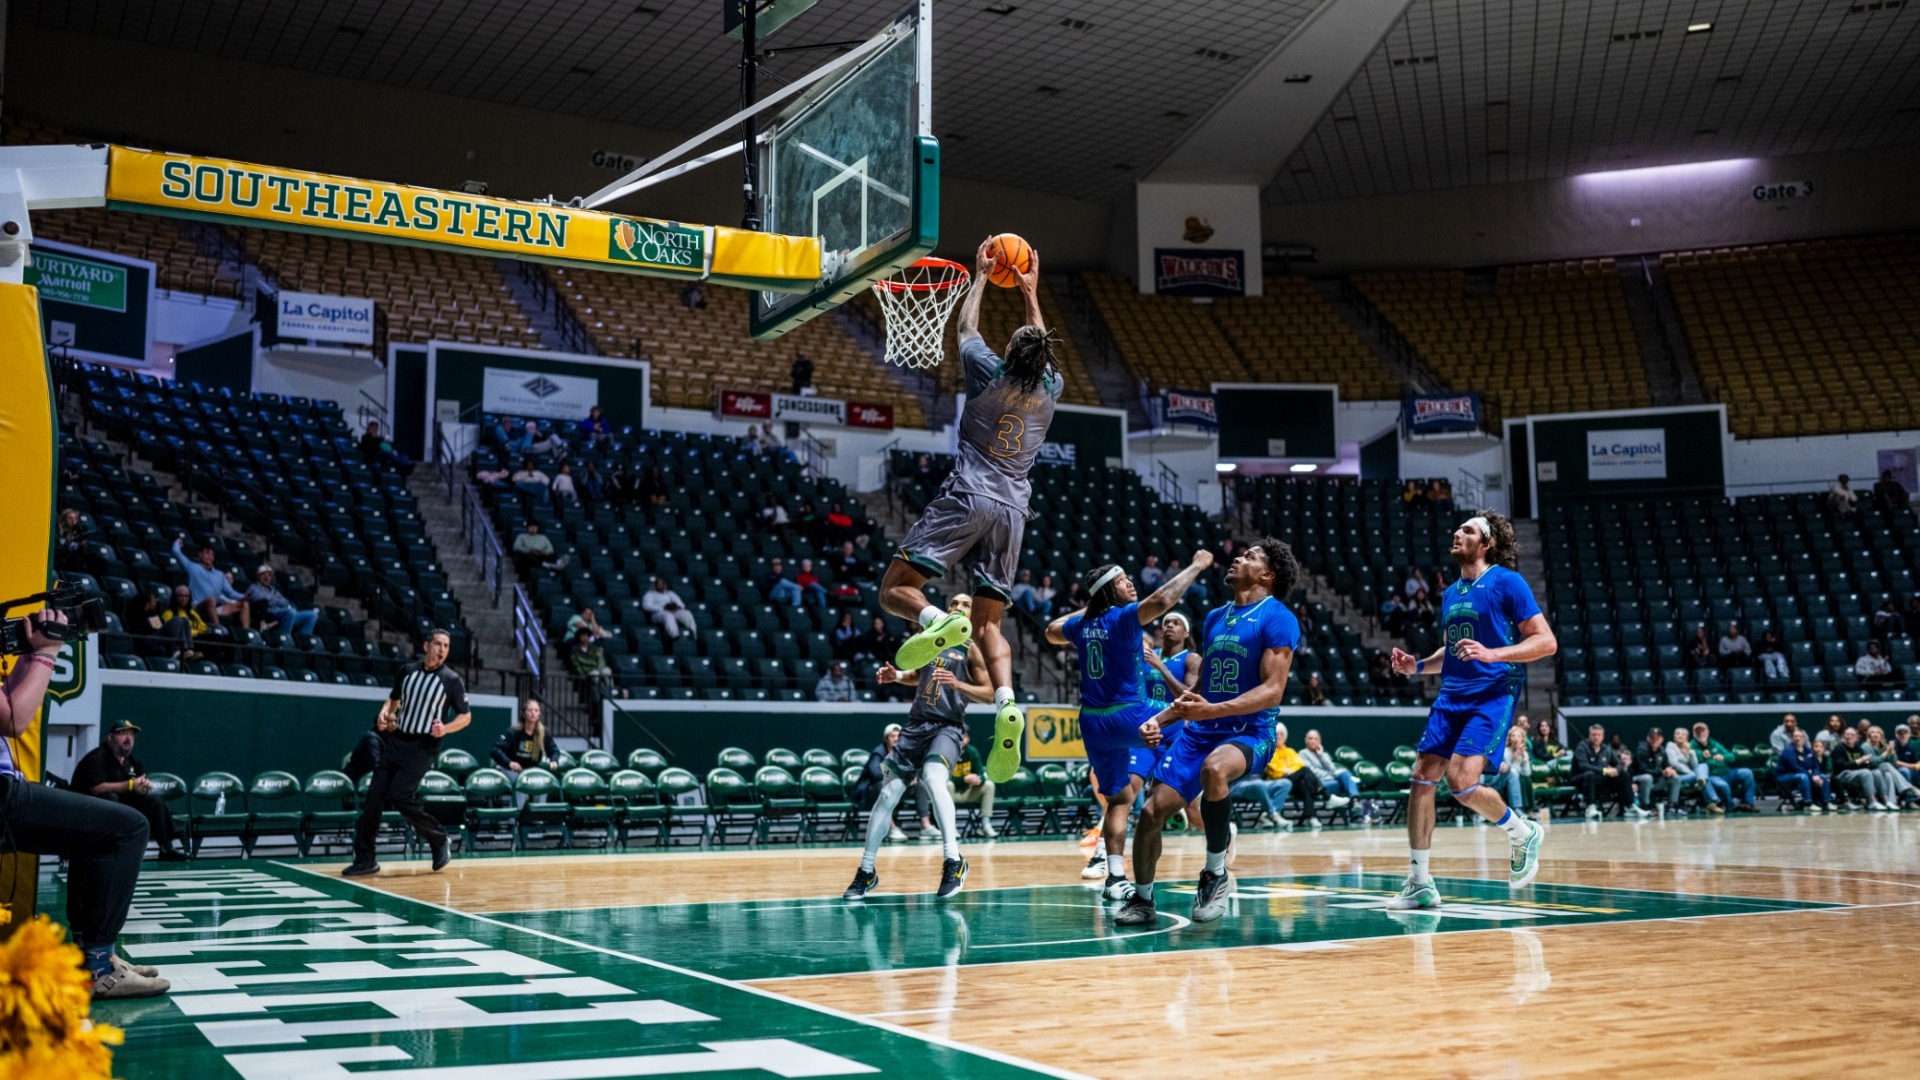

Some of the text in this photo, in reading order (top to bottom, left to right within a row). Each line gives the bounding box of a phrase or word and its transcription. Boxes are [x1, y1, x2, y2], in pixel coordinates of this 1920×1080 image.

[592, 151, 634, 171] Gate
[1753, 181, 1814, 200] Gate 3
[161, 161, 570, 249] SOUTHEASTERN
[636, 223, 700, 250] NORTH
[641, 241, 692, 265] OAKS
[30, 256, 115, 283] URTYARD
[37, 273, 91, 292] Marriott
[283, 301, 369, 322] La Capitol
[777, 398, 841, 415] CONCESSIONS
[989, 413, 1024, 458] 3
[1591, 442, 1662, 458] La Capitol
[1087, 640, 1104, 679] 0
[1209, 657, 1239, 693] 22
[922, 678, 941, 705] 4
